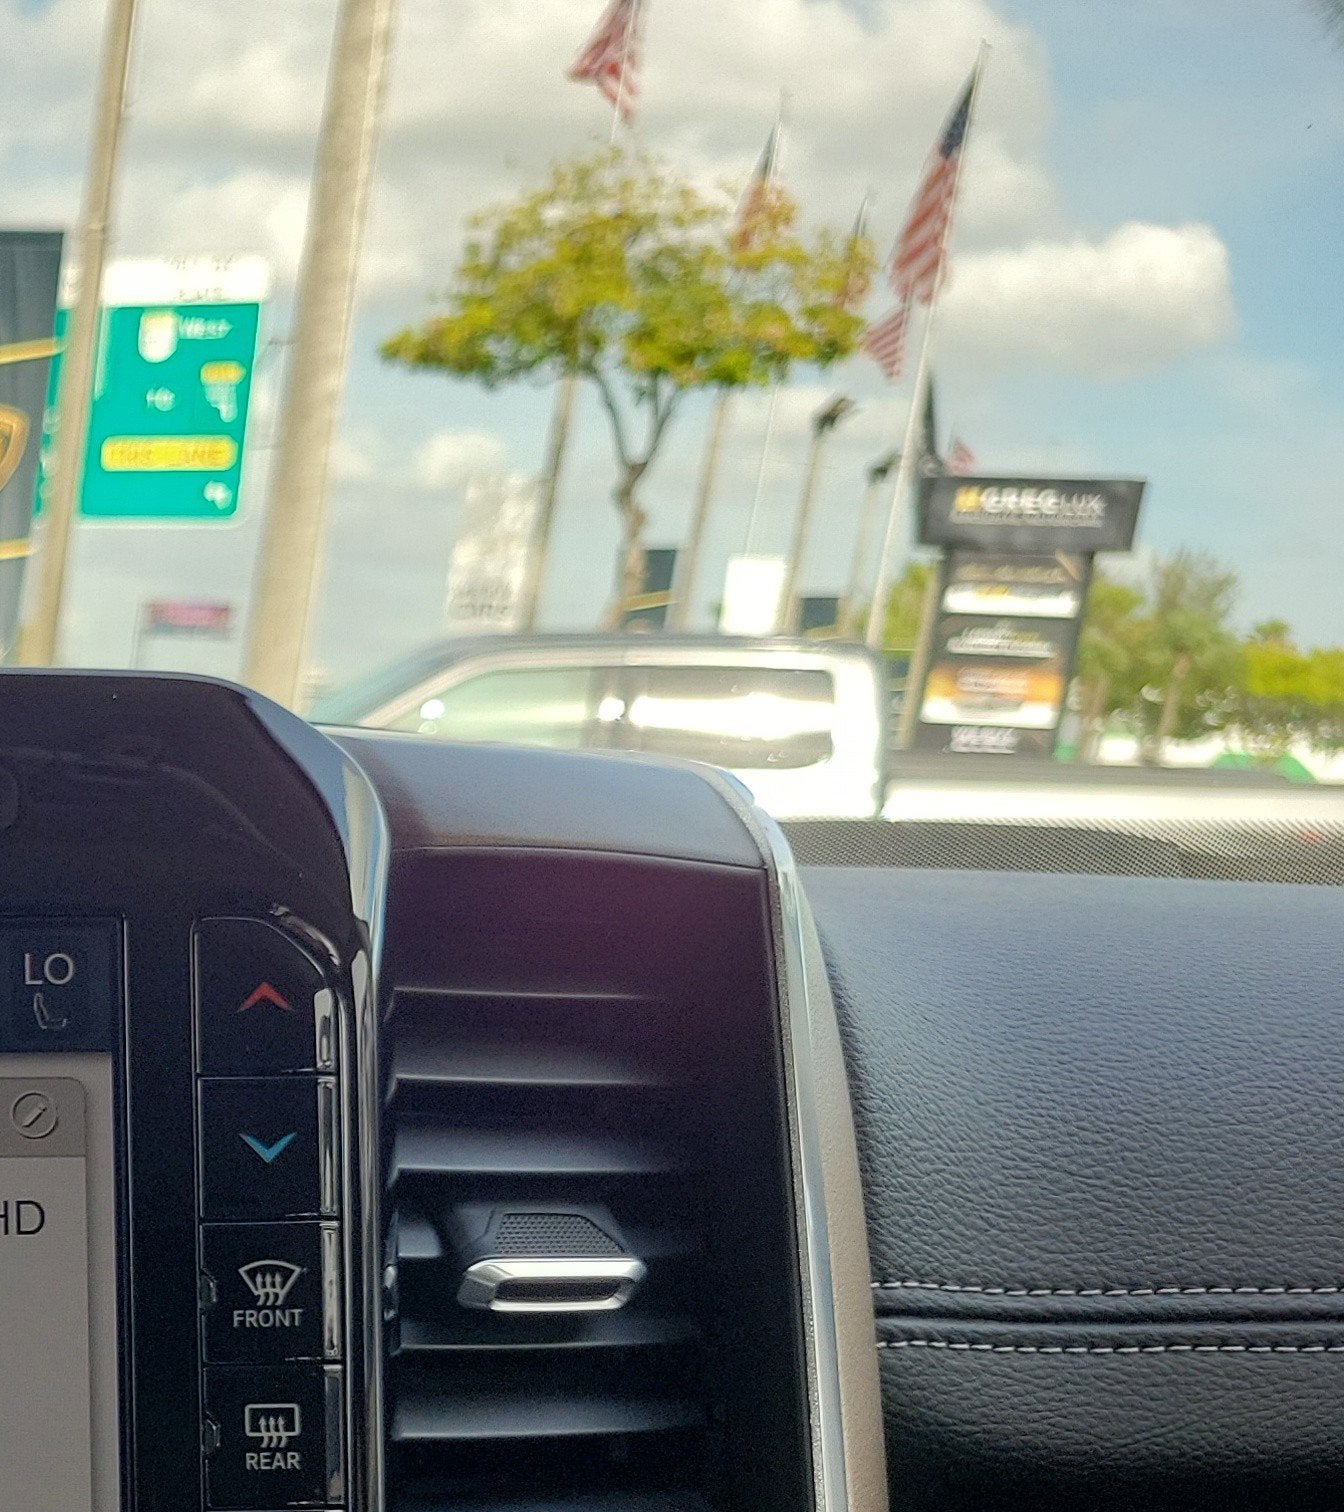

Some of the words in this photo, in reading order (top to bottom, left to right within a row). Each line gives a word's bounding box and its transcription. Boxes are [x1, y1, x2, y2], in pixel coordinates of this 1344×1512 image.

[24, 953, 73, 985] LO
[233, 1309, 302, 1328] FRONT
[246, 1453, 301, 1471] REAR
